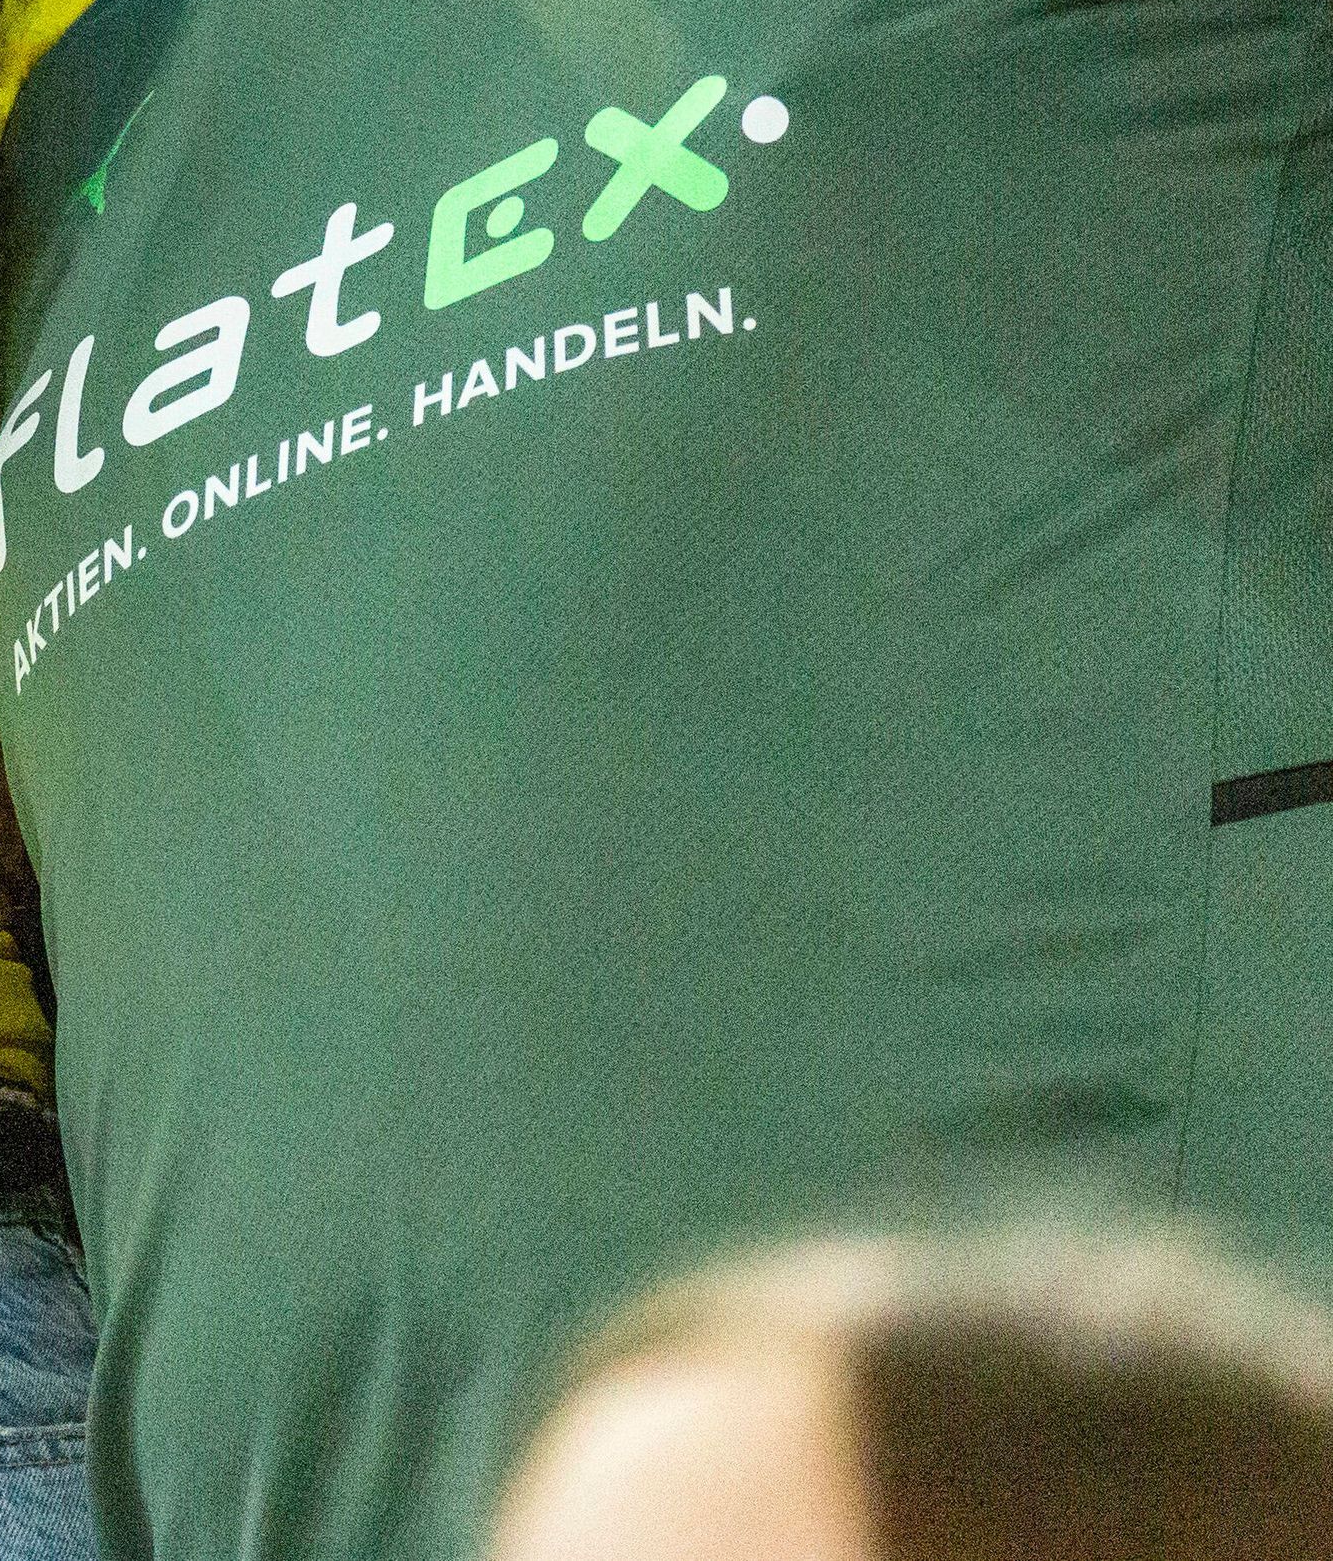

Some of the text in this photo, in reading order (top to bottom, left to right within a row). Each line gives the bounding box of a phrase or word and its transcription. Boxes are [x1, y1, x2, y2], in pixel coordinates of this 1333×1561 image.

[13, 287, 757, 696] AKTIEN. ONLINE. HANDELN.
